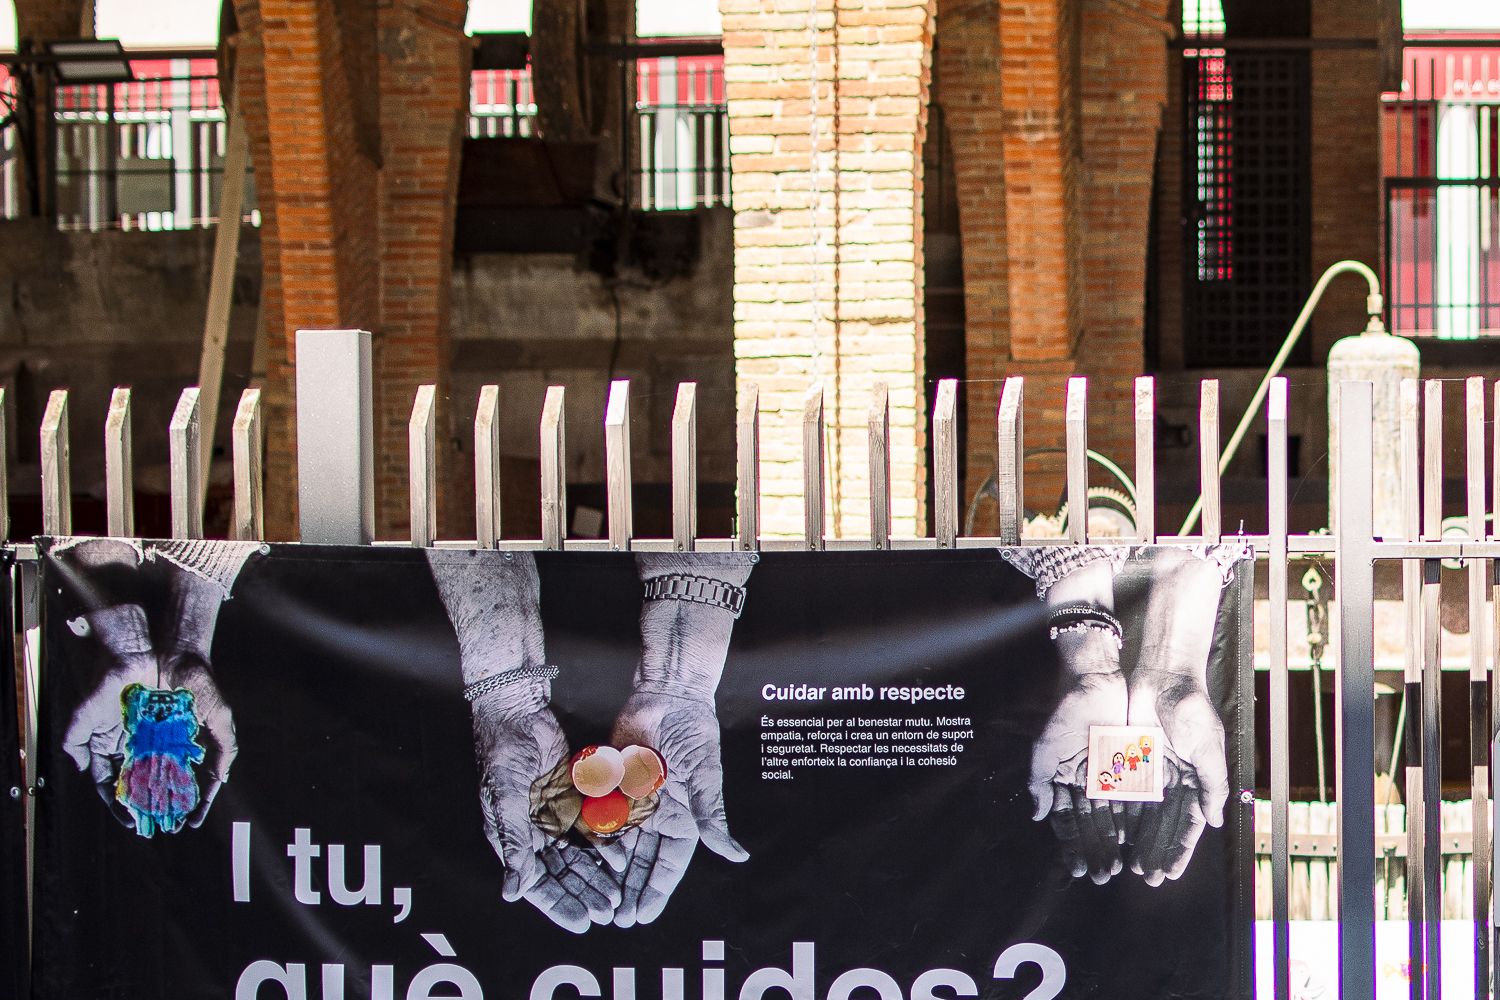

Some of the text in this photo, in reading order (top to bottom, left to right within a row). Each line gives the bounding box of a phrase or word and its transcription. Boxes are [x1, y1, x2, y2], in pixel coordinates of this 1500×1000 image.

[762, 683, 965, 704] Cuidar amb respecte
[761, 715, 971, 729] És essencial per al benestar mutu. Mostra
[760, 729, 974, 742] empatia, reforça i crea un entorn de suport
[761, 742, 964, 756] i seguretat. Respectar les necessitats de
[761, 755, 957, 768] l'altre enforteix la confiança i la cohesió
[762, 770, 794, 780] social.
[232, 821, 412, 924] I tu,
